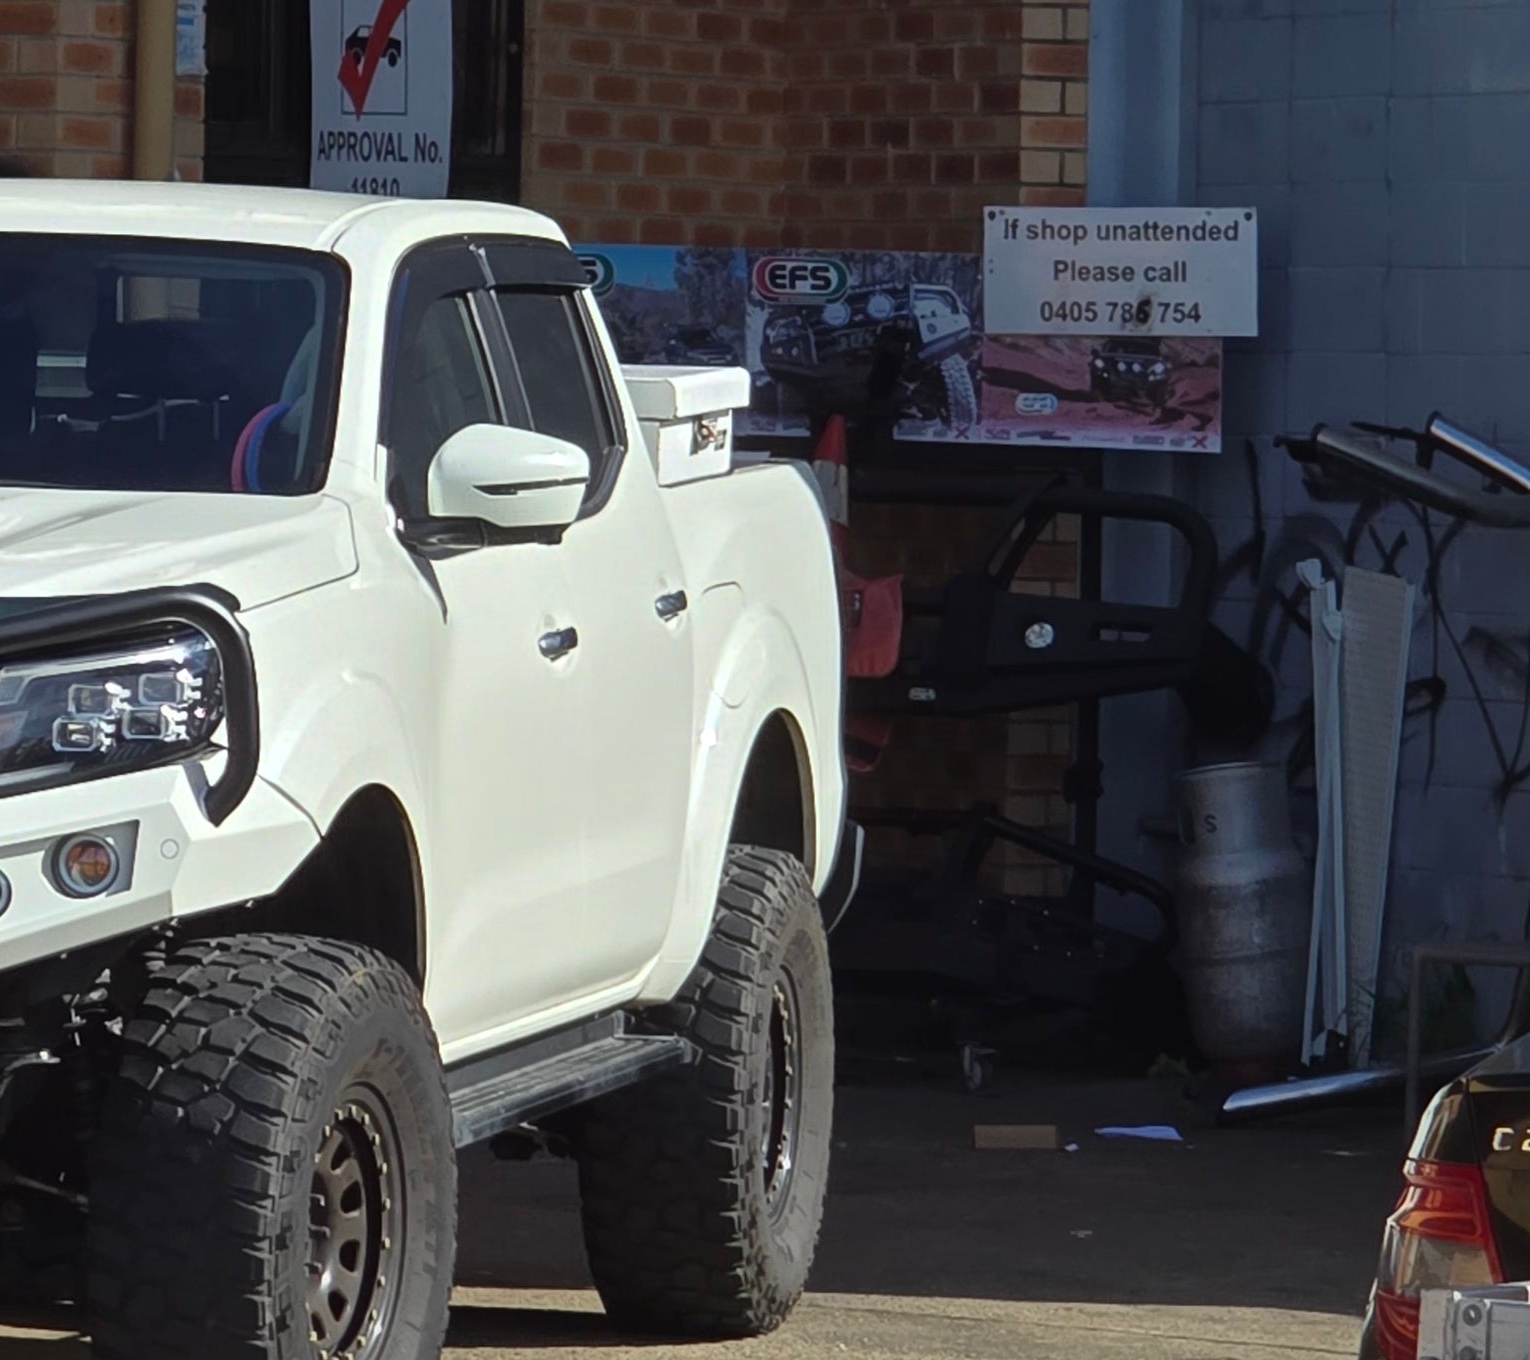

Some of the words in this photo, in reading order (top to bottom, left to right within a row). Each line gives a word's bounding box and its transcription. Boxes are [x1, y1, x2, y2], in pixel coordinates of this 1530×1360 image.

[317, 131, 408, 163] APPROVAL
[414, 133, 443, 164] No.
[1003, 218, 1019, 239] If
[1026, 219, 1087, 246] shop
[1096, 220, 1239, 241] unattended
[769, 265, 832, 291] EFS
[1053, 260, 1135, 282] Please
[1144, 260, 1187, 282] call
[1040, 301, 1098, 323] 0405
[1157, 302, 1201, 323] 754
